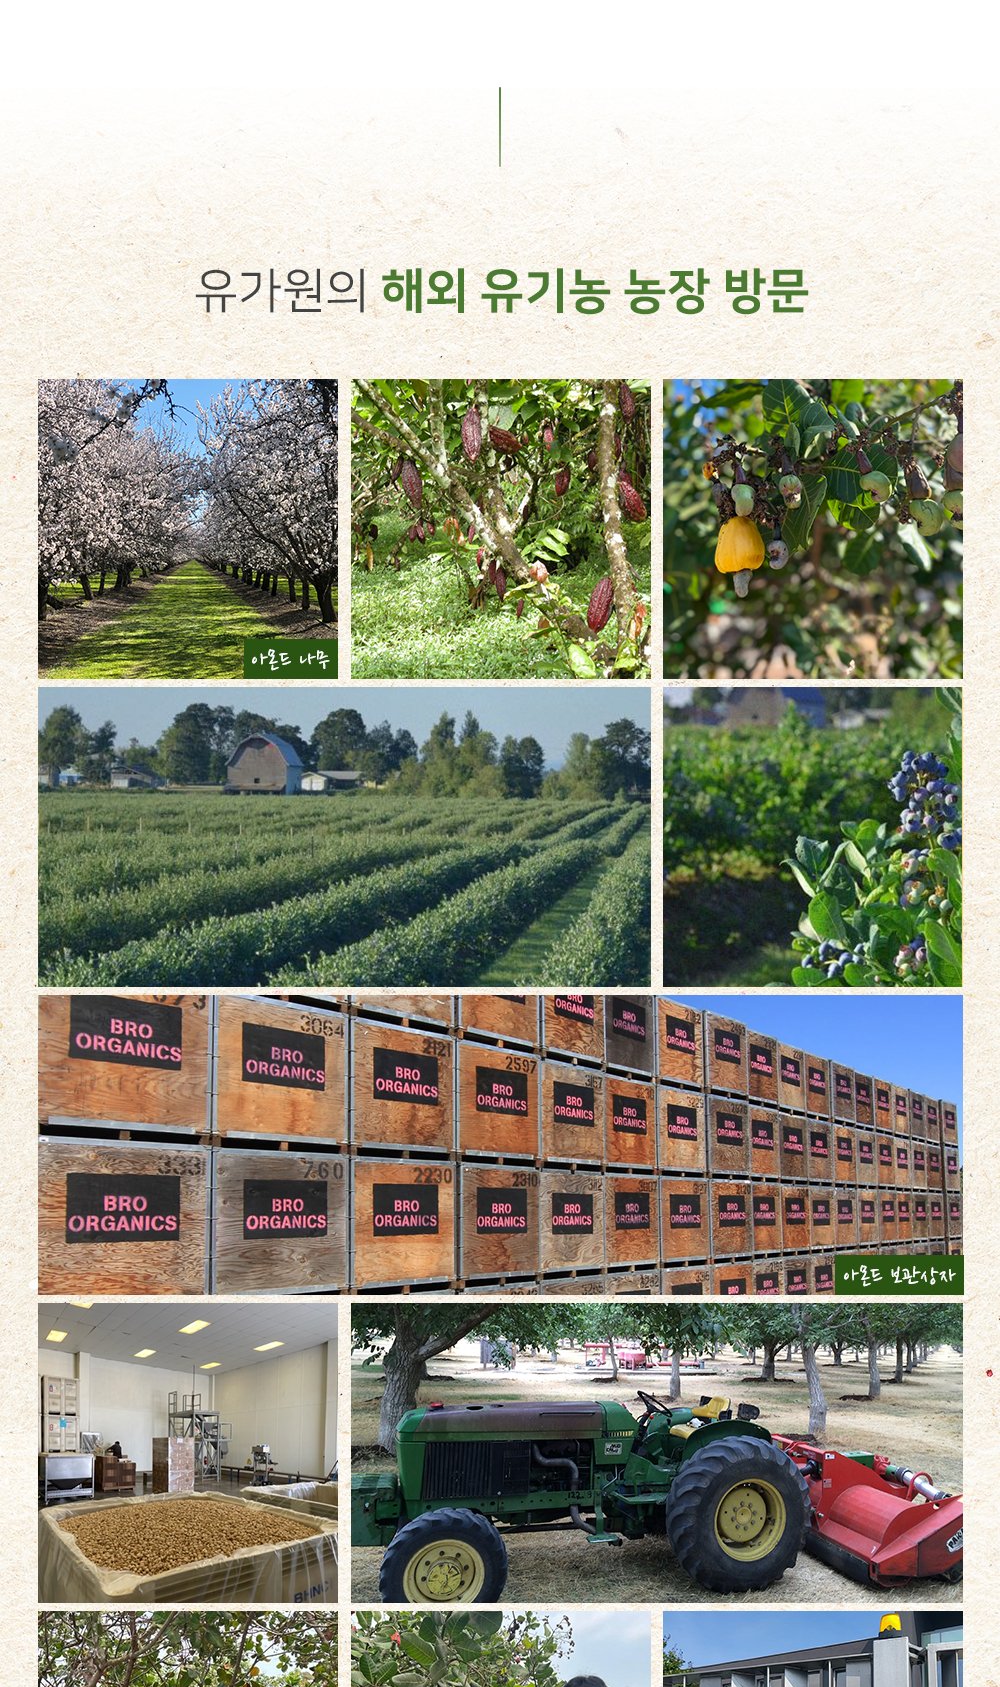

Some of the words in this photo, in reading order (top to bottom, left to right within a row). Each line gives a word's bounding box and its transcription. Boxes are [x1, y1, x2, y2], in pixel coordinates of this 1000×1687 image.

[110, 1018, 153, 1039] BRO
[301, 1015, 344, 1038] 3064
[76, 1033, 182, 1062] ORGANICS
[271, 1047, 303, 1063] BRO
[246, 1060, 325, 1083] ORGANICS
[566, 1096, 582, 1107] BRO
[554, 1105, 593, 1120] ORGANICS
[303, 1161, 343, 1179] 760
[414, 1168, 452, 1184] 2230
[103, 1195, 147, 1212] BRO
[394, 1200, 420, 1212] BRO
[68, 1215, 177, 1232] ORGANICS
[374, 1214, 437, 1227] ORGANICS
